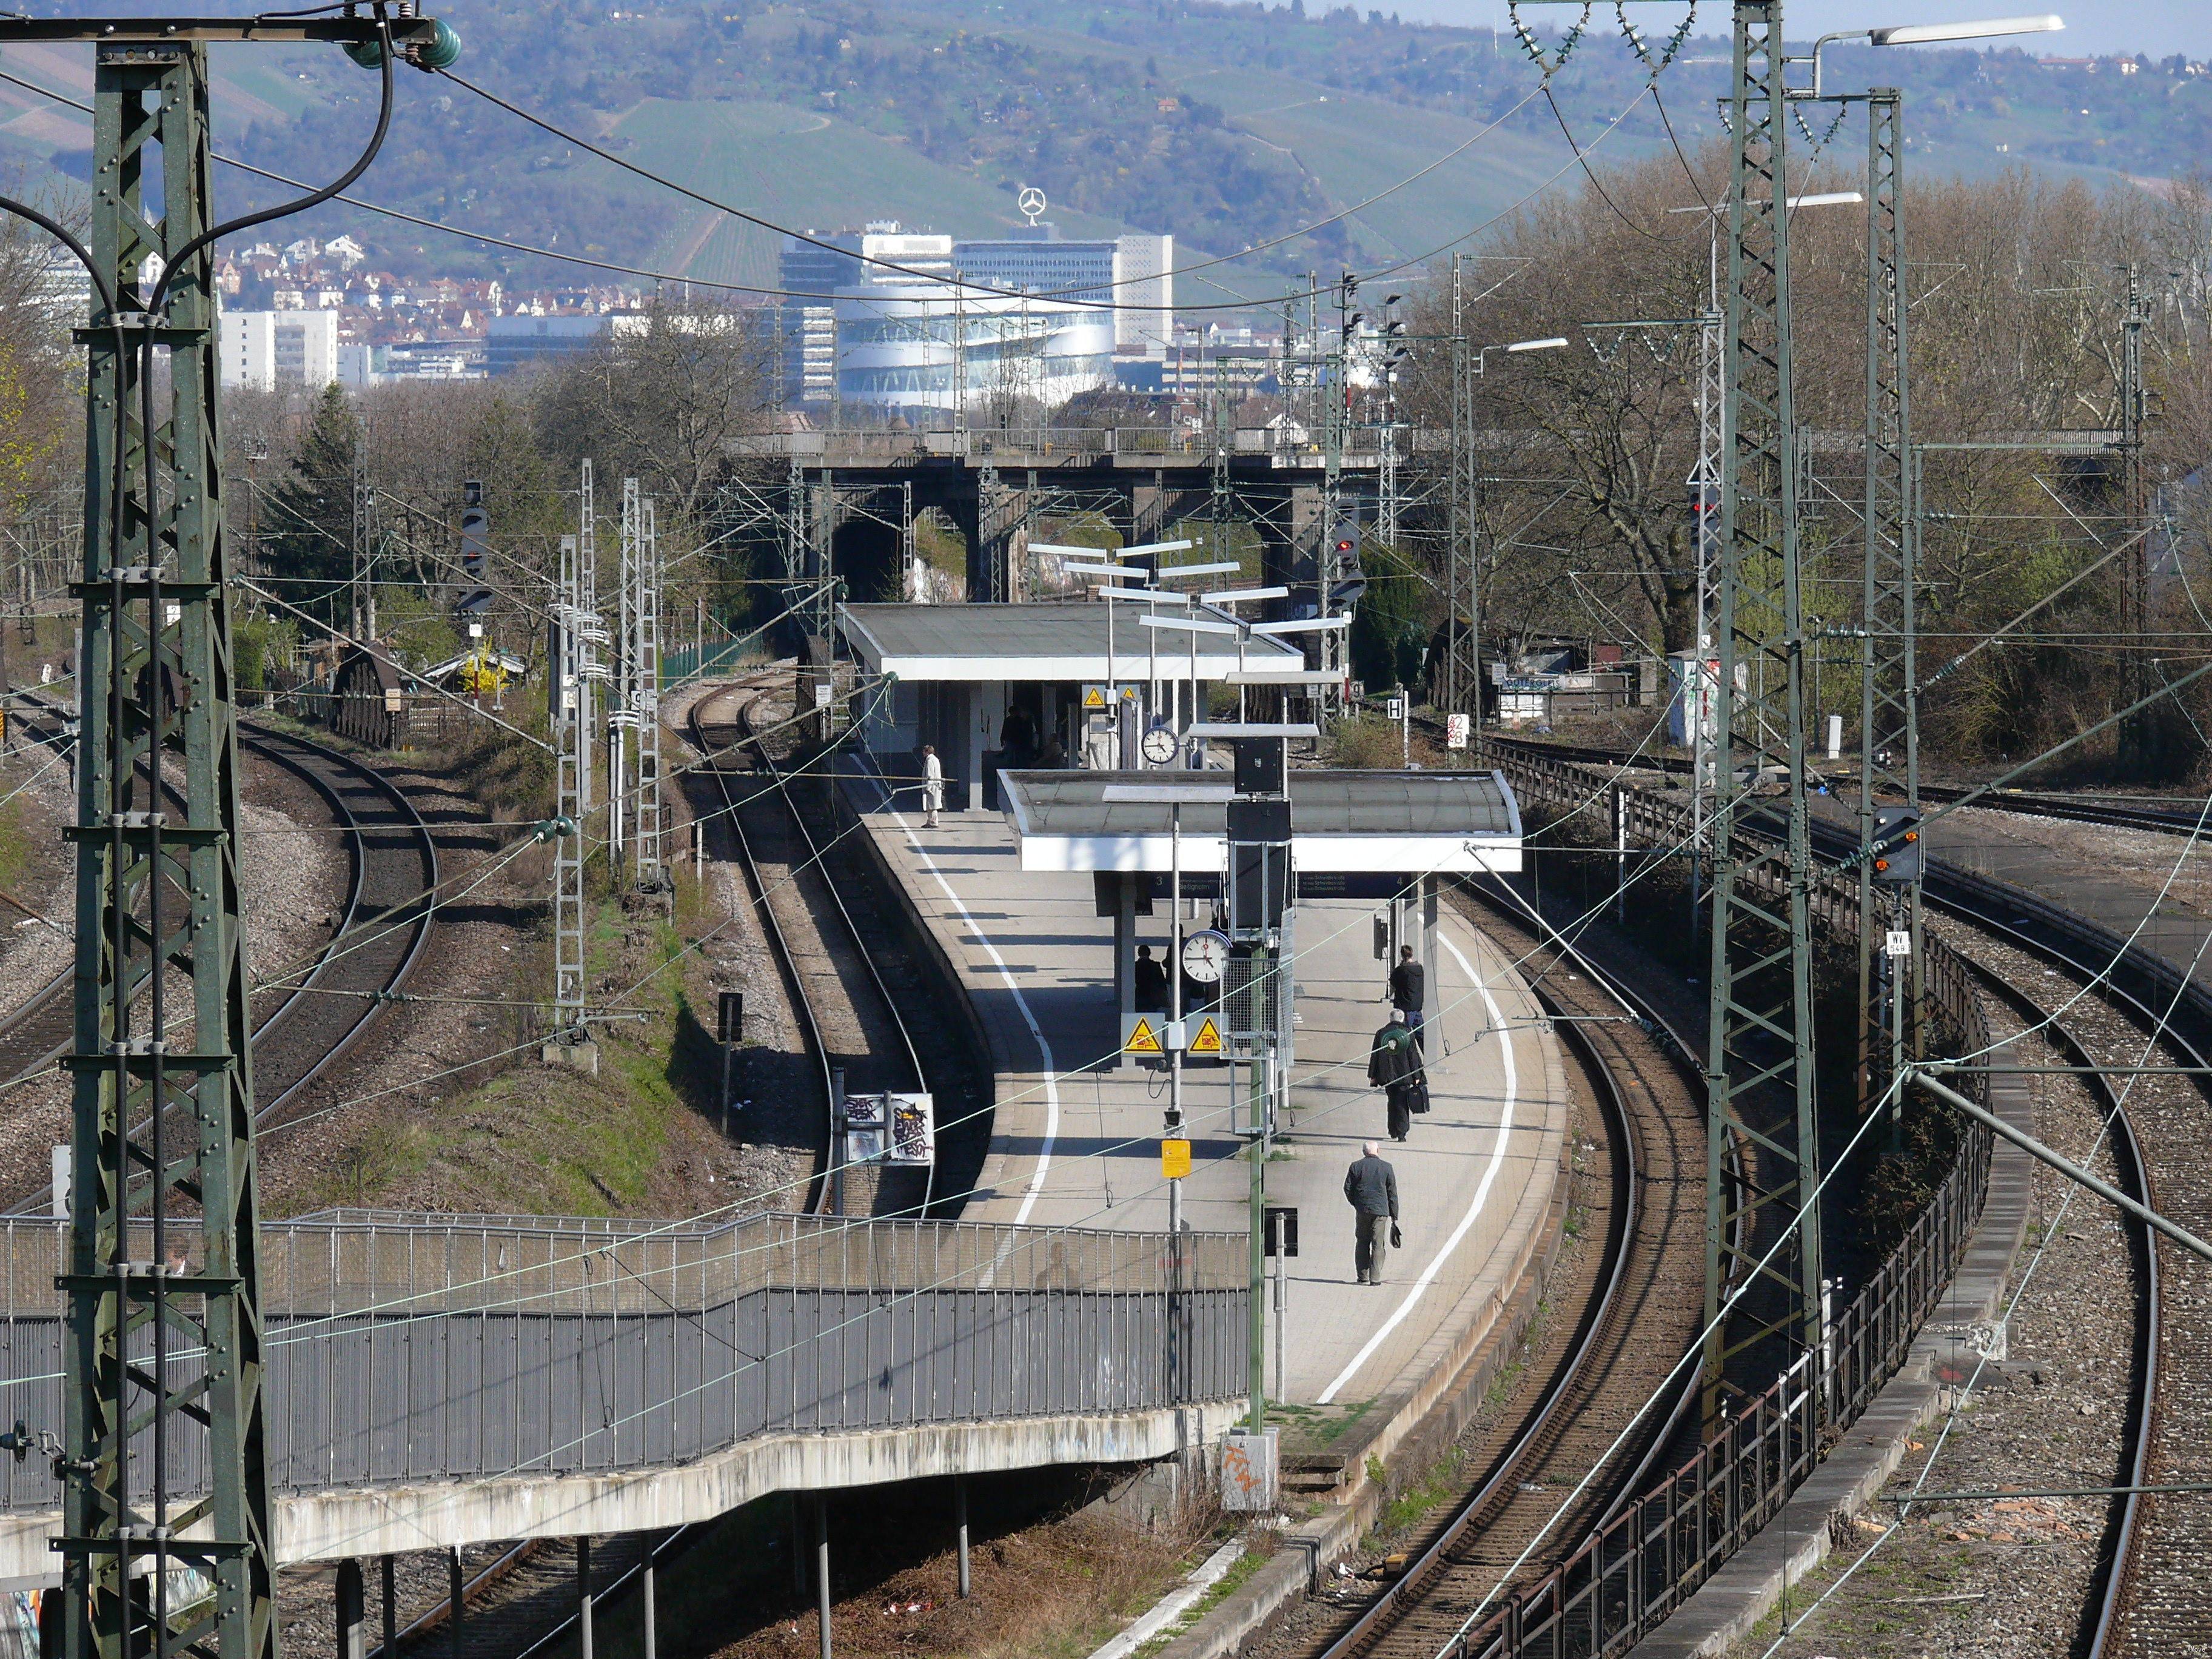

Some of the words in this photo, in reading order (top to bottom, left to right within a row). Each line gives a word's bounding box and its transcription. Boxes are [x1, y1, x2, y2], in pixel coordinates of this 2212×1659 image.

[1390, 701, 1399, 717] H
[1455, 716, 1463, 729] 2
[1455, 731, 1463, 744] 8
[1156, 876, 1163, 886] 3
[1396, 877, 1403, 885] 4
